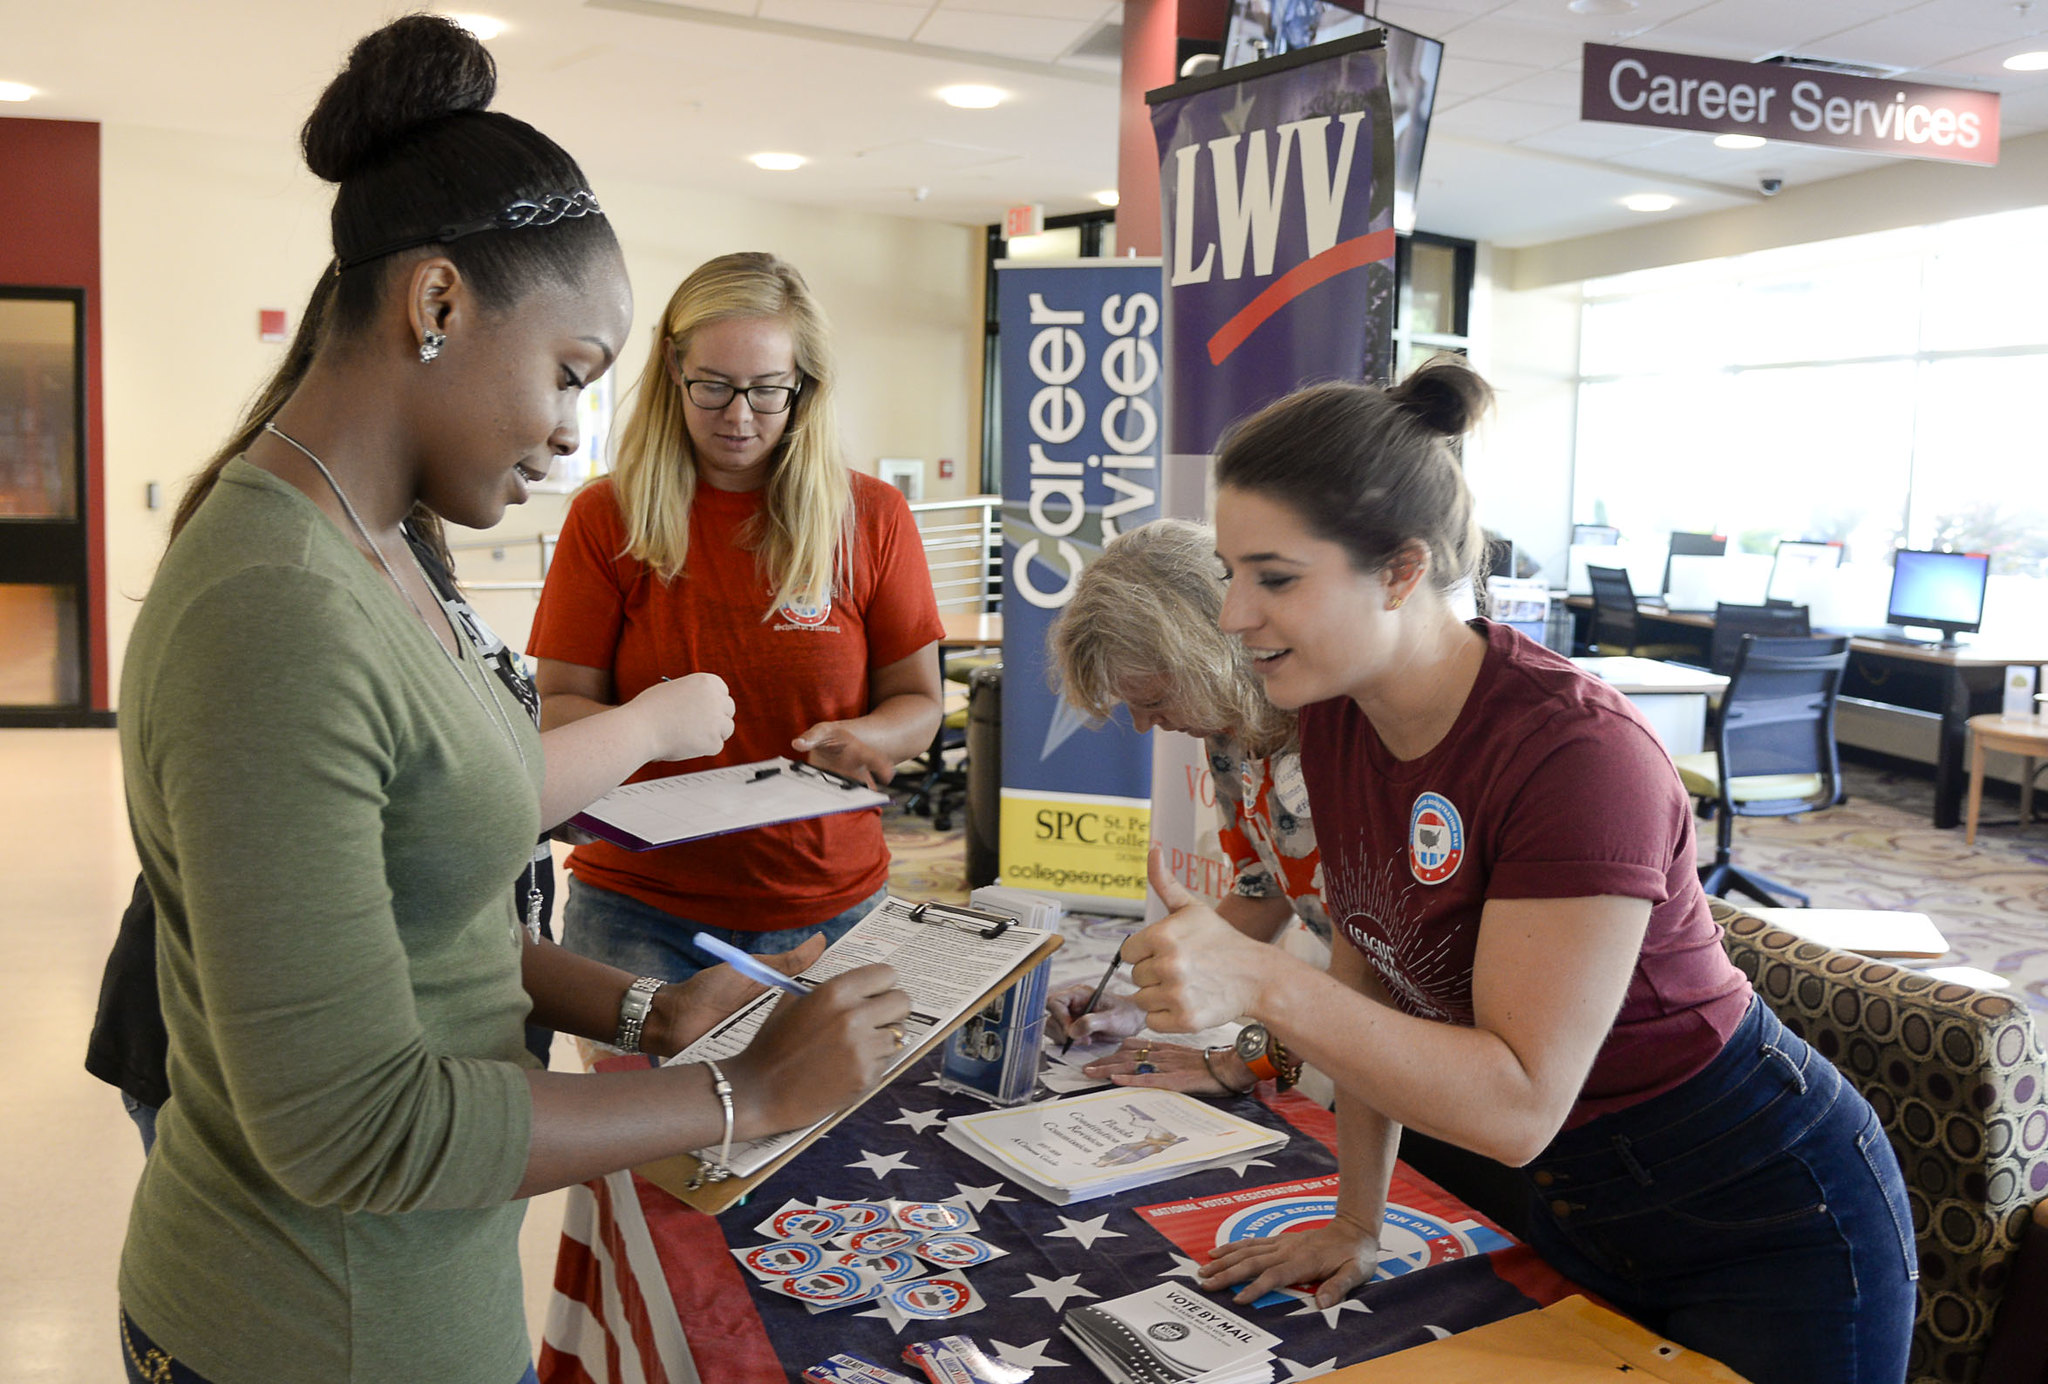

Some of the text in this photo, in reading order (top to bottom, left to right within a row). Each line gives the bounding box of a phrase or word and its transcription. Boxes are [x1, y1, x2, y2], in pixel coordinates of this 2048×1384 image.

[1608, 58, 1981, 149] Career Services
[1007, 205, 1032, 236] EXIT
[1172, 110, 1366, 287] LWV
[1087, 291, 1160, 550] rvices
[1013, 292, 1086, 610] Career
[1185, 763, 1217, 809] VO
[1035, 809, 1147, 844] SPC St. Pe
[1103, 830, 1147, 848] Colle
[1148, 1202, 1202, 1217] NATIONAL
[1197, 1196, 1235, 1209] VOTER
[1232, 1183, 1306, 1203] REGISTRATION
[1303, 1180, 1325, 1191] DAY
[1245, 1211, 1286, 1231] VOTER
[1409, 1221, 1441, 1236] DAY
[1166, 1291, 1203, 1313] VOTE
[1198, 1310, 1222, 1323] BY
[1217, 1321, 1253, 1344] MAIL
